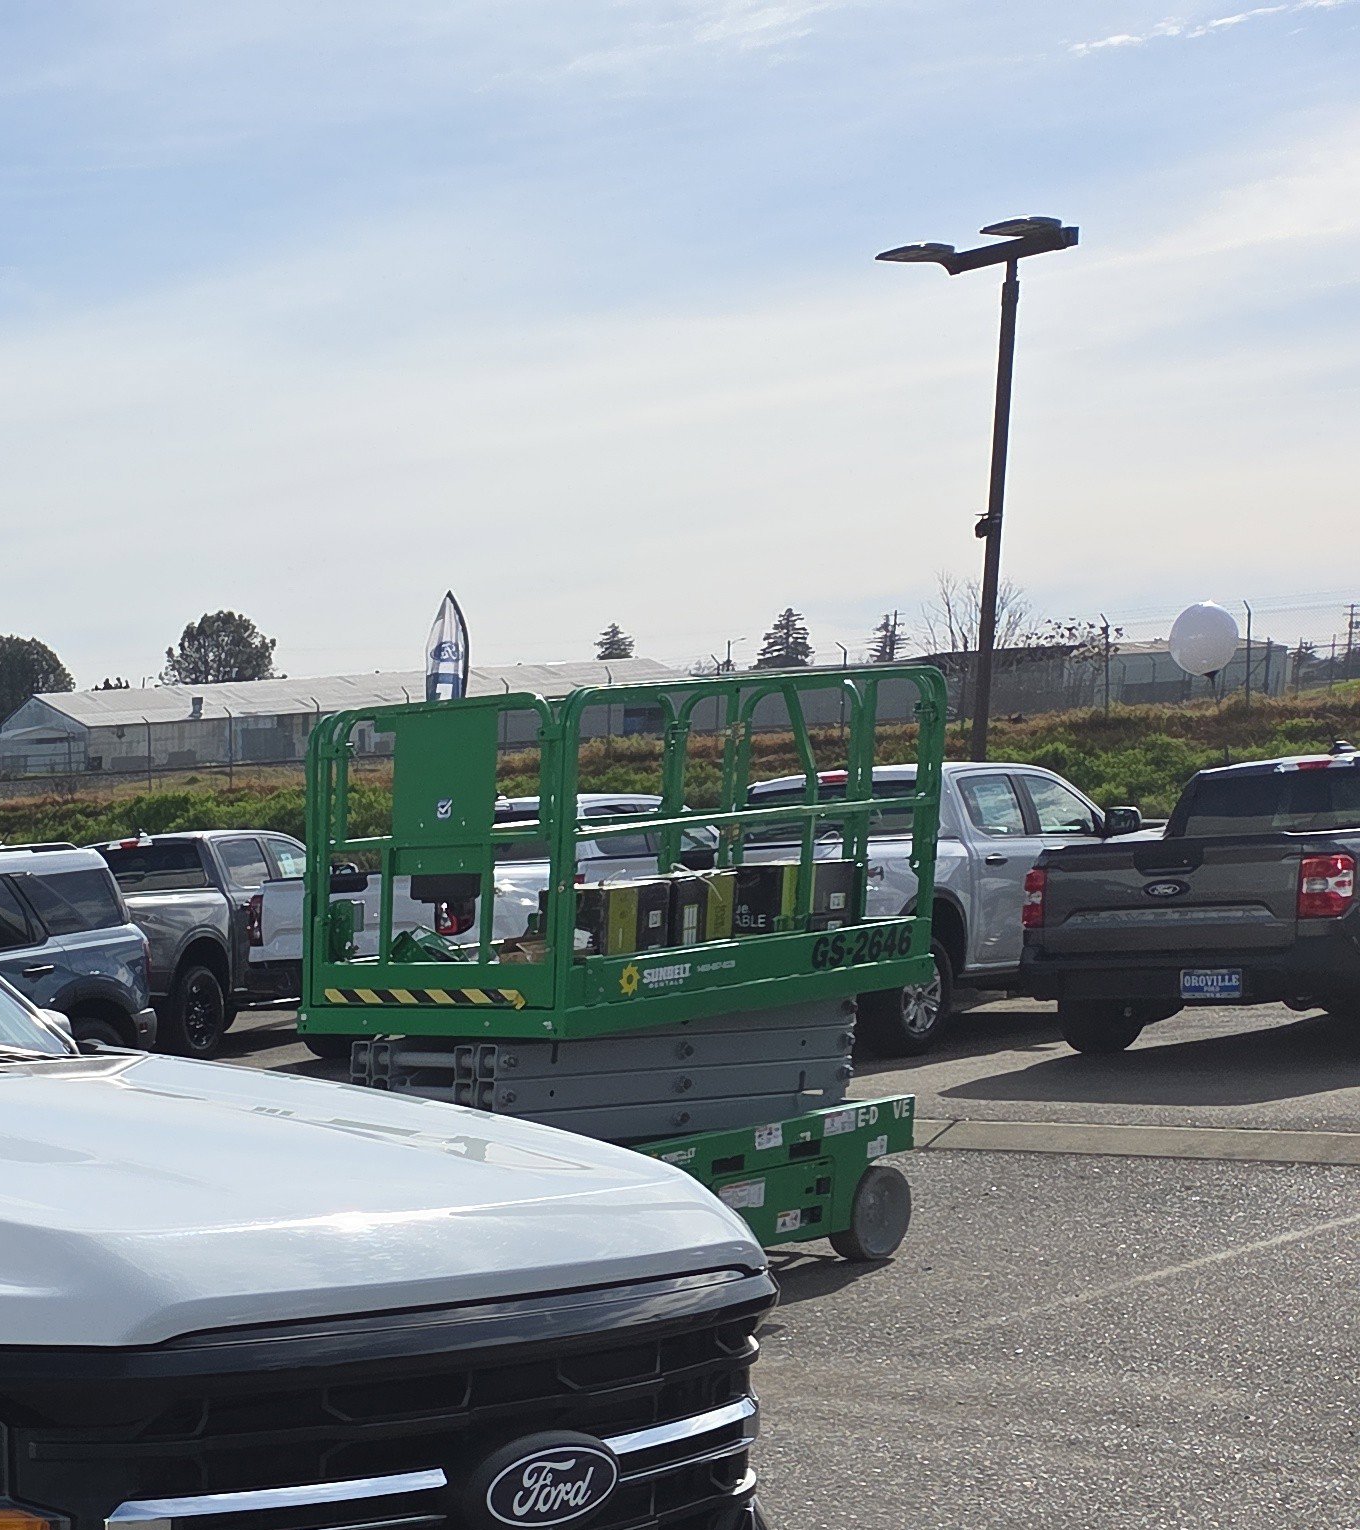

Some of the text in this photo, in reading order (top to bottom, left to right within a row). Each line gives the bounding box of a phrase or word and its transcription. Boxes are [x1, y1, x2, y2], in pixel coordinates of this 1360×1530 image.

[812, 923, 913, 970] GS-2646
[1184, 975, 1240, 987] OROVILLE
[512, 1458, 595, 1517] Ford
